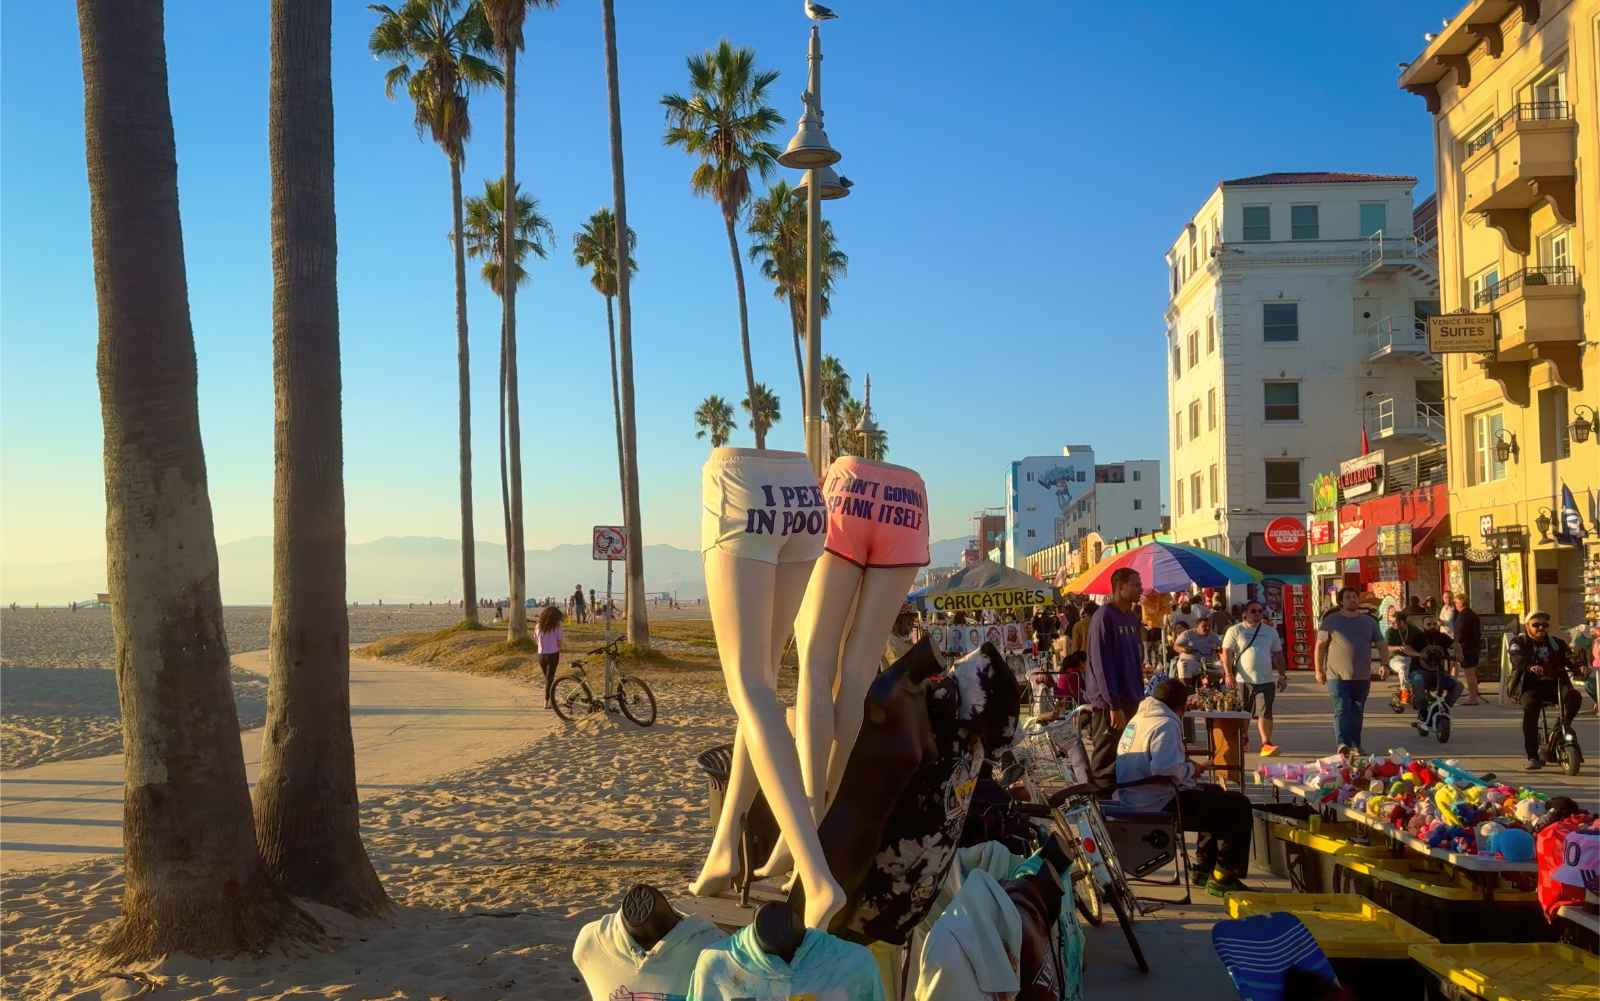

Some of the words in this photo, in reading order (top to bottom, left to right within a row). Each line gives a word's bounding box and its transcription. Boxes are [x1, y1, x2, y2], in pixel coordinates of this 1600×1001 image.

[1440, 326, 1485, 337] SUITES
[761, 484, 777, 507] I
[841, 478, 880, 498] AIN'T
[745, 508, 777, 535] IN
[878, 503, 923, 530] ITSELF
[933, 589, 1046, 611] CARICATURES
